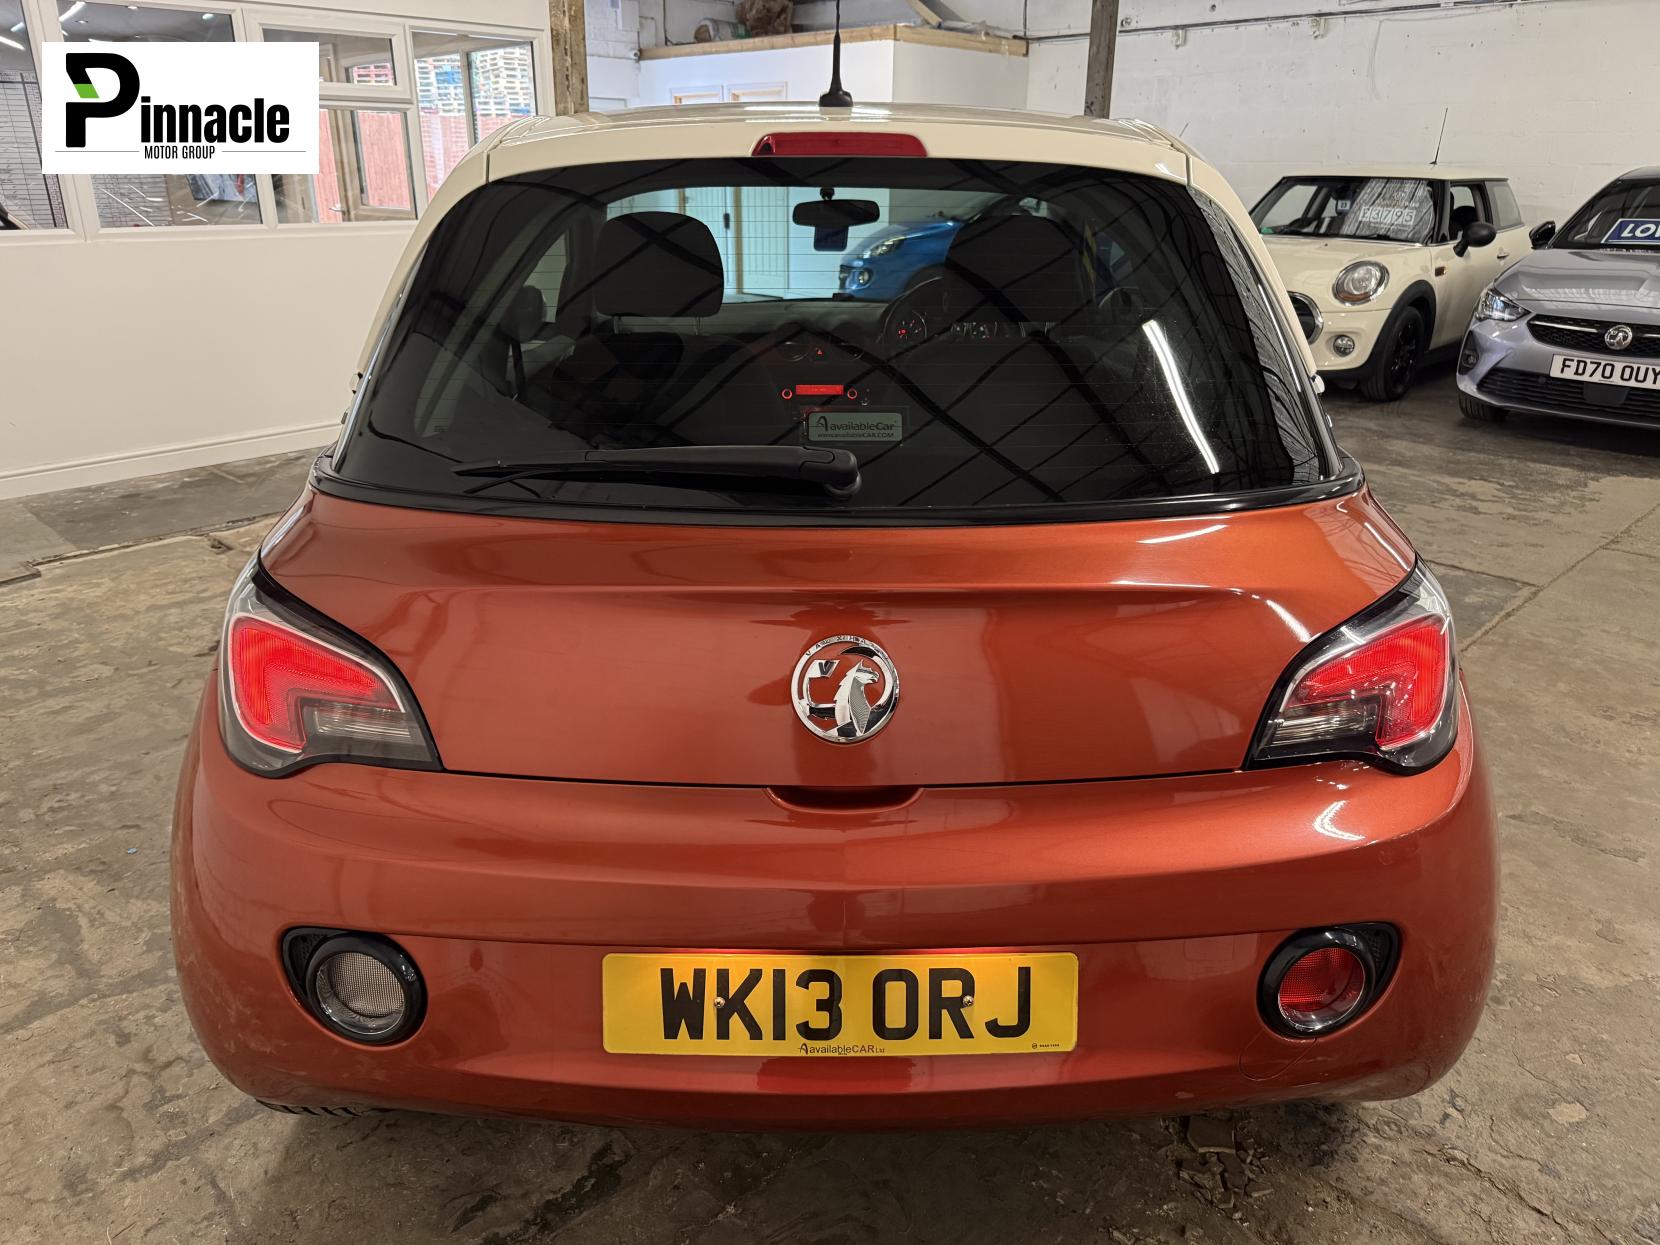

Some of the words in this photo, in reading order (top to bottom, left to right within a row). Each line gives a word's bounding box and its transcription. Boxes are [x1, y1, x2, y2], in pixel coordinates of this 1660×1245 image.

[1560, 358, 1615, 380] FD70
[1620, 365, 1660, 385] OUY
[660, 967, 843, 1041] WK13
[872, 966, 1031, 1041] ORJ
